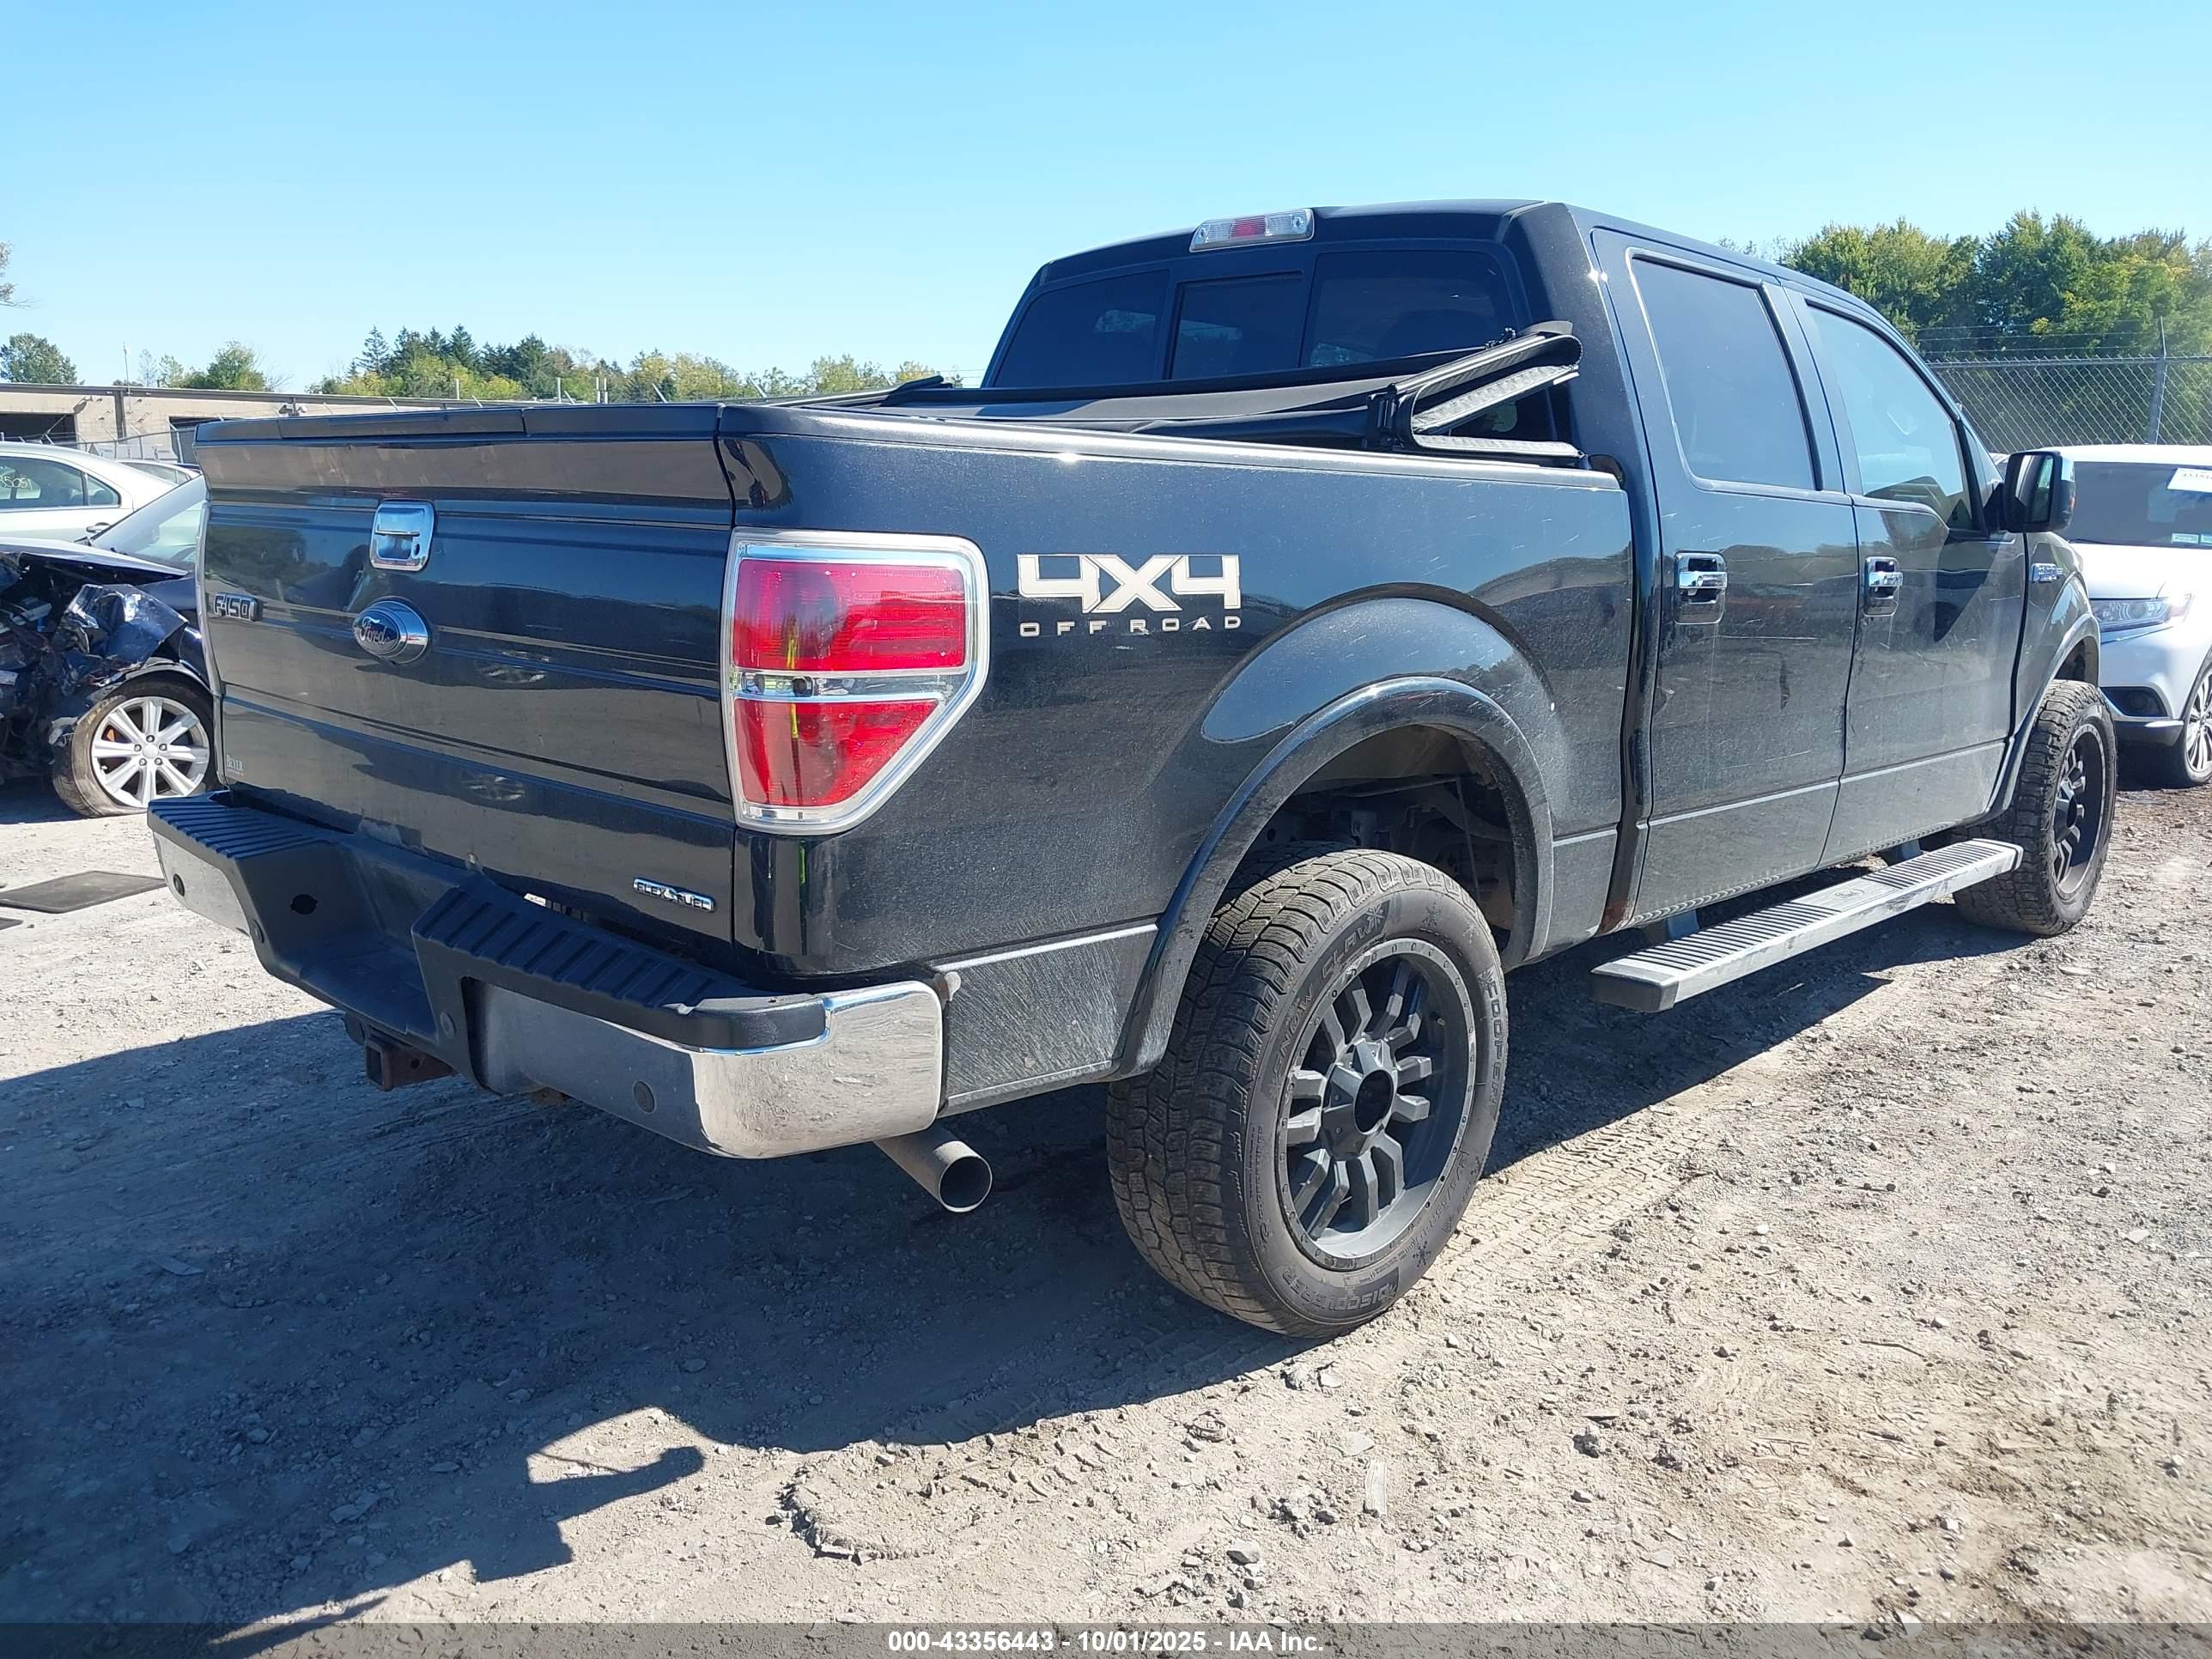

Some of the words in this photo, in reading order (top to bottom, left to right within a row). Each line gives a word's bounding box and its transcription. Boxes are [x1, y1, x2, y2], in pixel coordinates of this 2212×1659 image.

[214, 594, 256, 622] F-150
[359, 617, 390, 646] Ford
[1019, 620, 1108, 637] OFF
[1129, 615, 1242, 636] ROAD
[636, 881, 667, 898] FLEX
[676, 894, 713, 912] FUEL
[1320, 921, 1376, 980] CLAW
[1281, 1267, 1390, 1311] DISCOVERER
